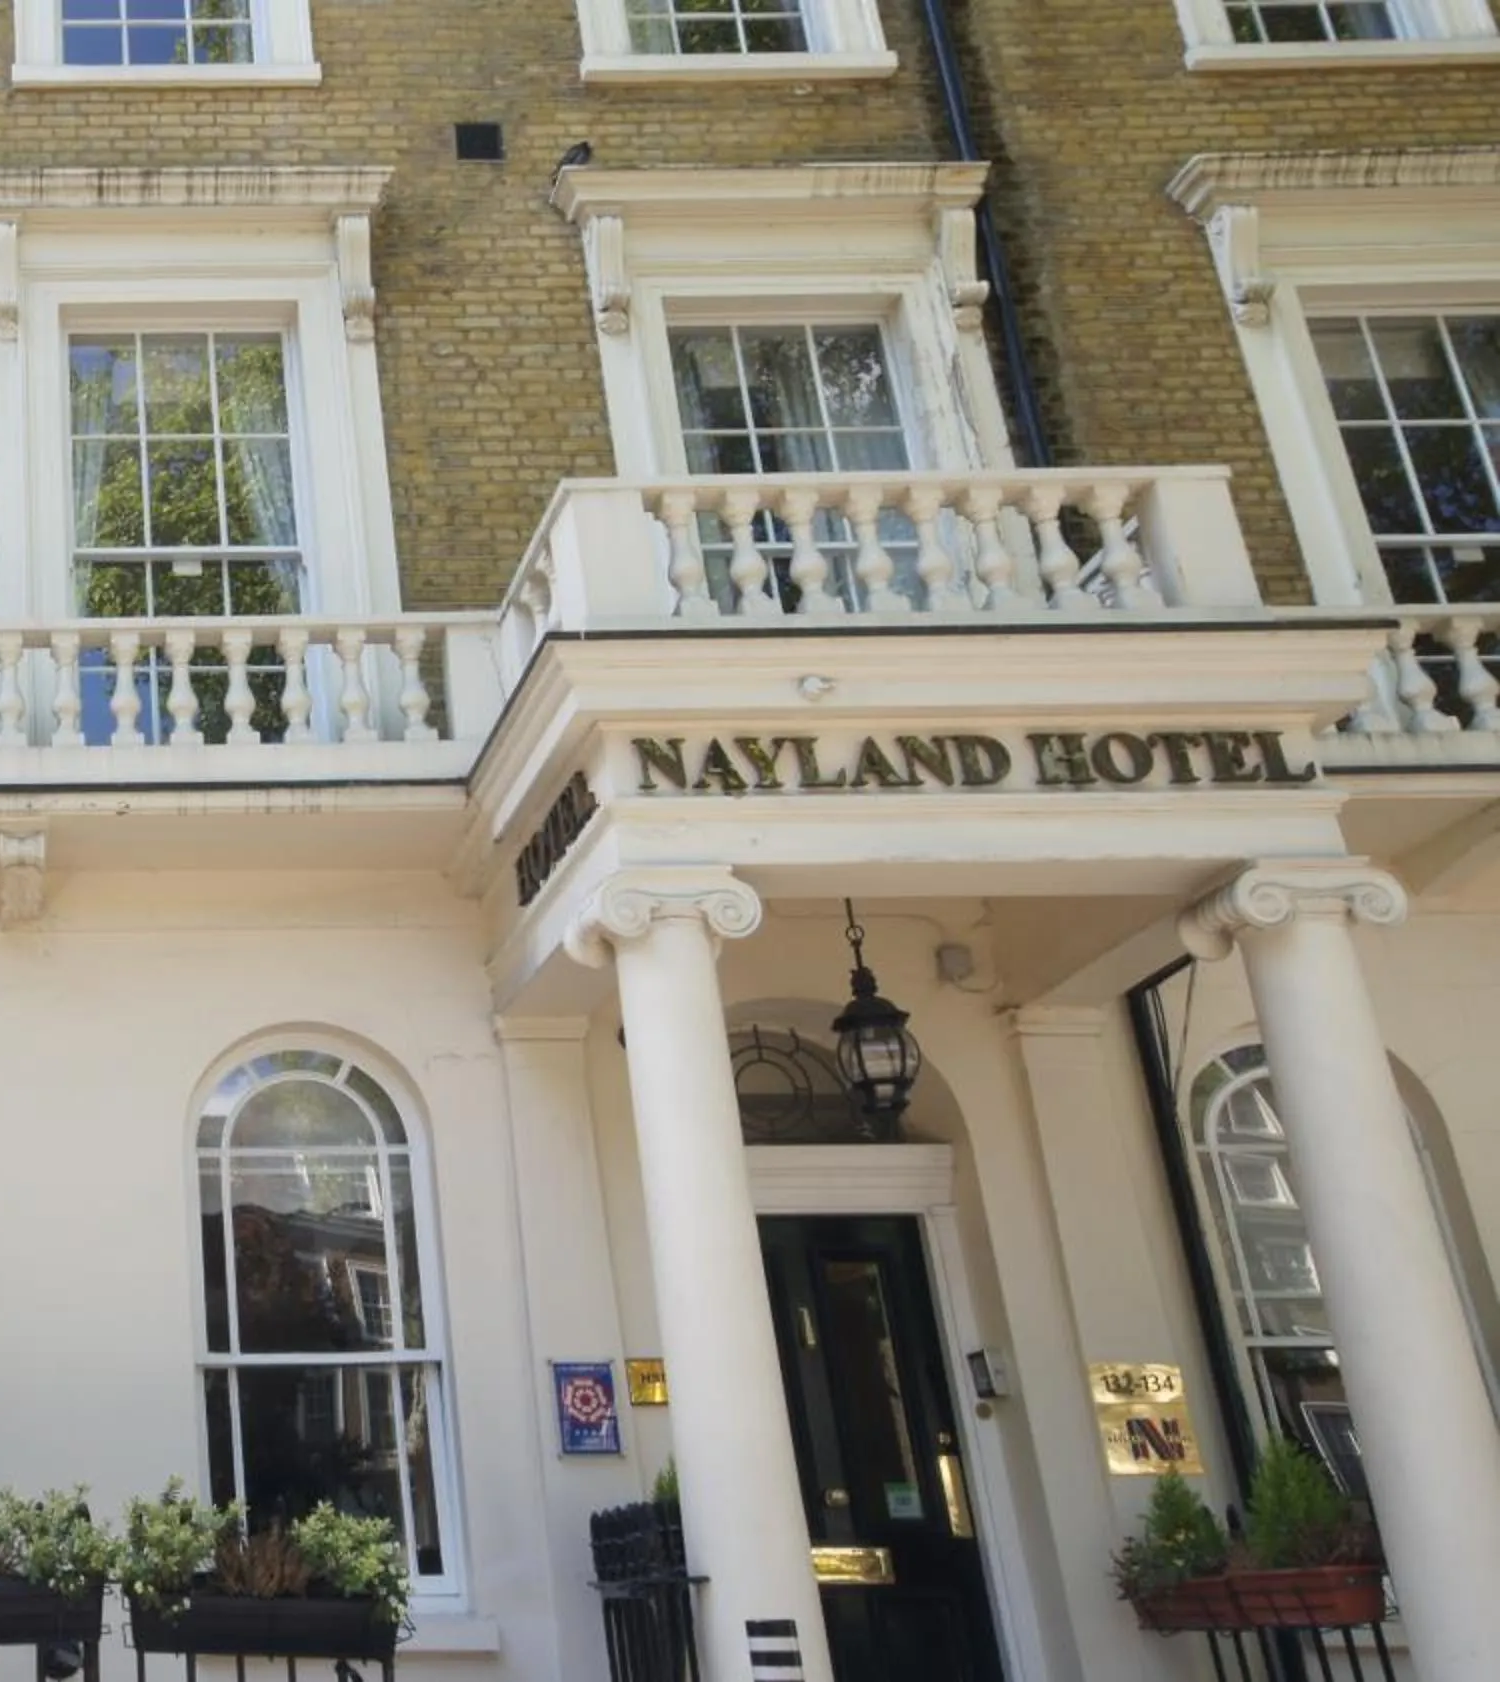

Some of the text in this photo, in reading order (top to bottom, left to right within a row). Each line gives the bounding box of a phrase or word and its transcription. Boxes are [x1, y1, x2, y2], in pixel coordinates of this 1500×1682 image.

[631, 730, 1316, 793] NAYLAND HOTEL
[1100, 1371, 1175, 1395] 132-134
